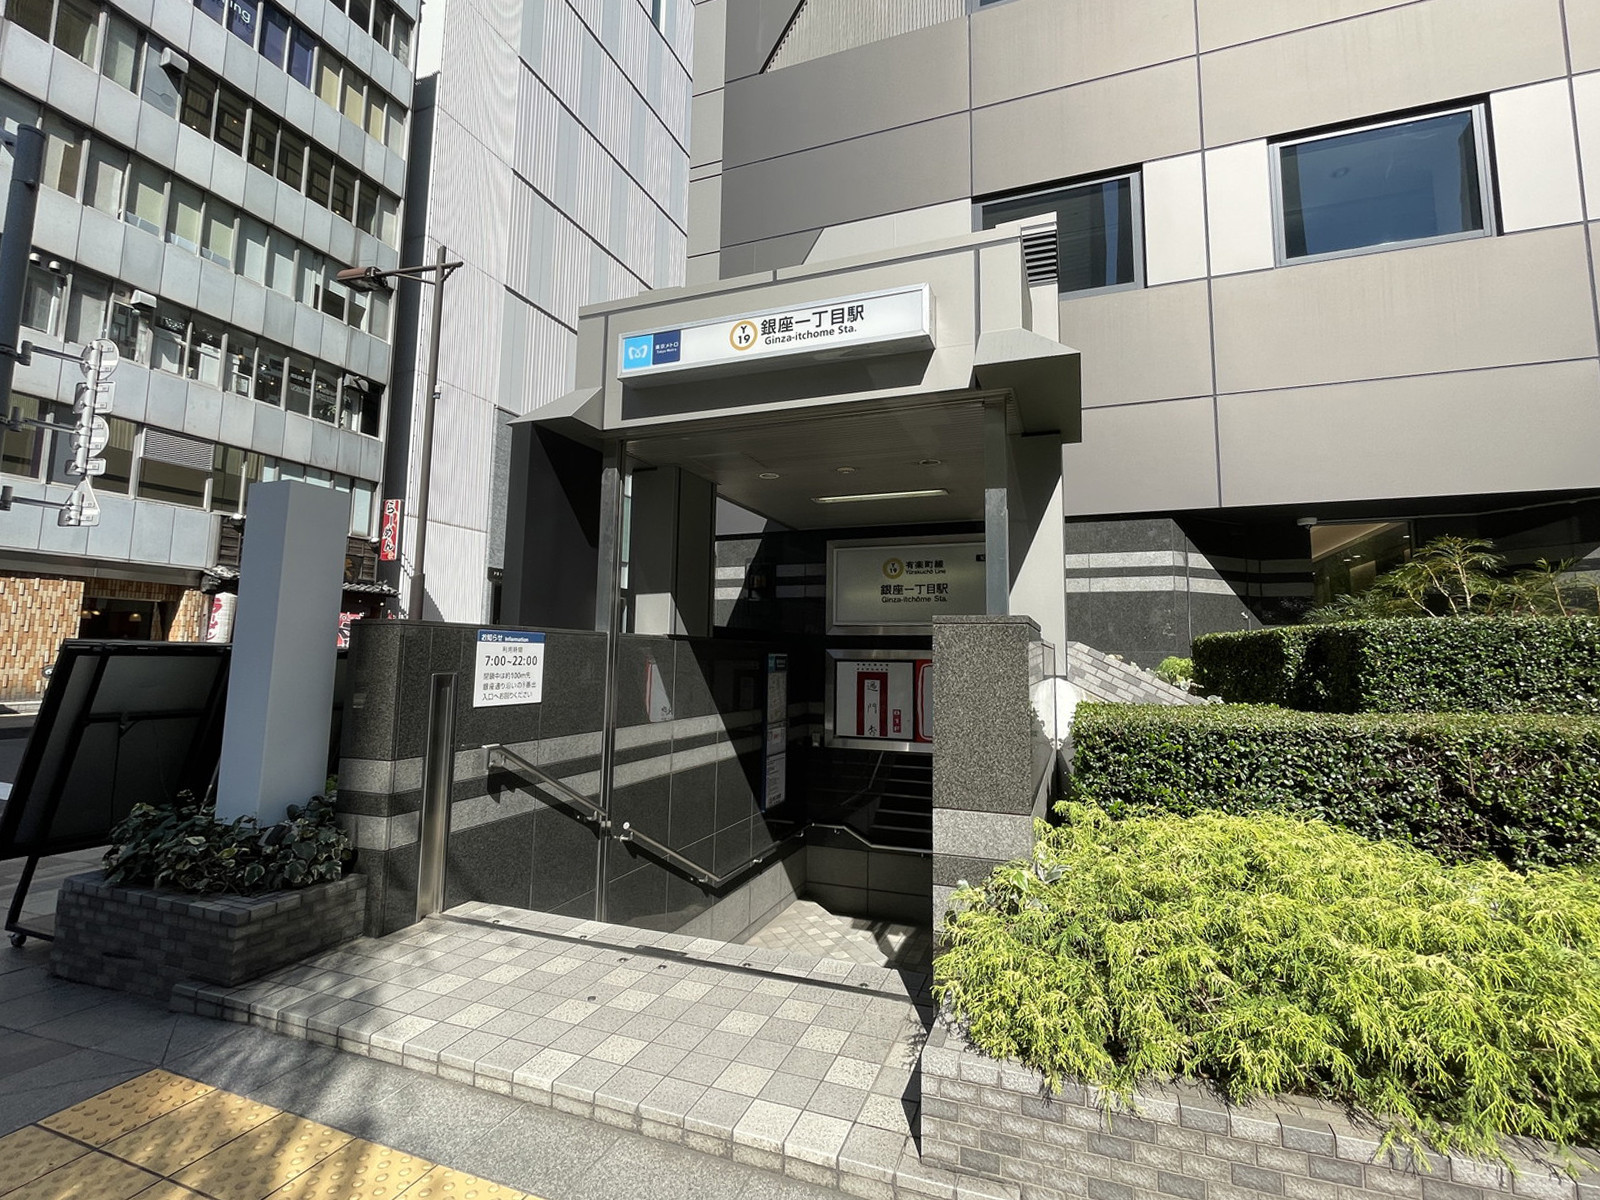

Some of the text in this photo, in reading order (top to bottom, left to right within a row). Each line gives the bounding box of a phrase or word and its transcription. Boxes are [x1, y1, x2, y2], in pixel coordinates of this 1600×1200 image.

[221, 0, 251, 24] ing
[761, 304, 864, 336] 銀座一丁目駅
[740, 325, 748, 334] Y
[764, 325, 857, 345] Ginza-itchome Sta.
[738, 334, 751, 344] 19
[383, 500, 395, 551] らーめん
[905, 560, 944, 569] 有楽町線
[880, 583, 949, 595] 銀座一丁目駅
[481, 634, 503, 642] お知らせ
